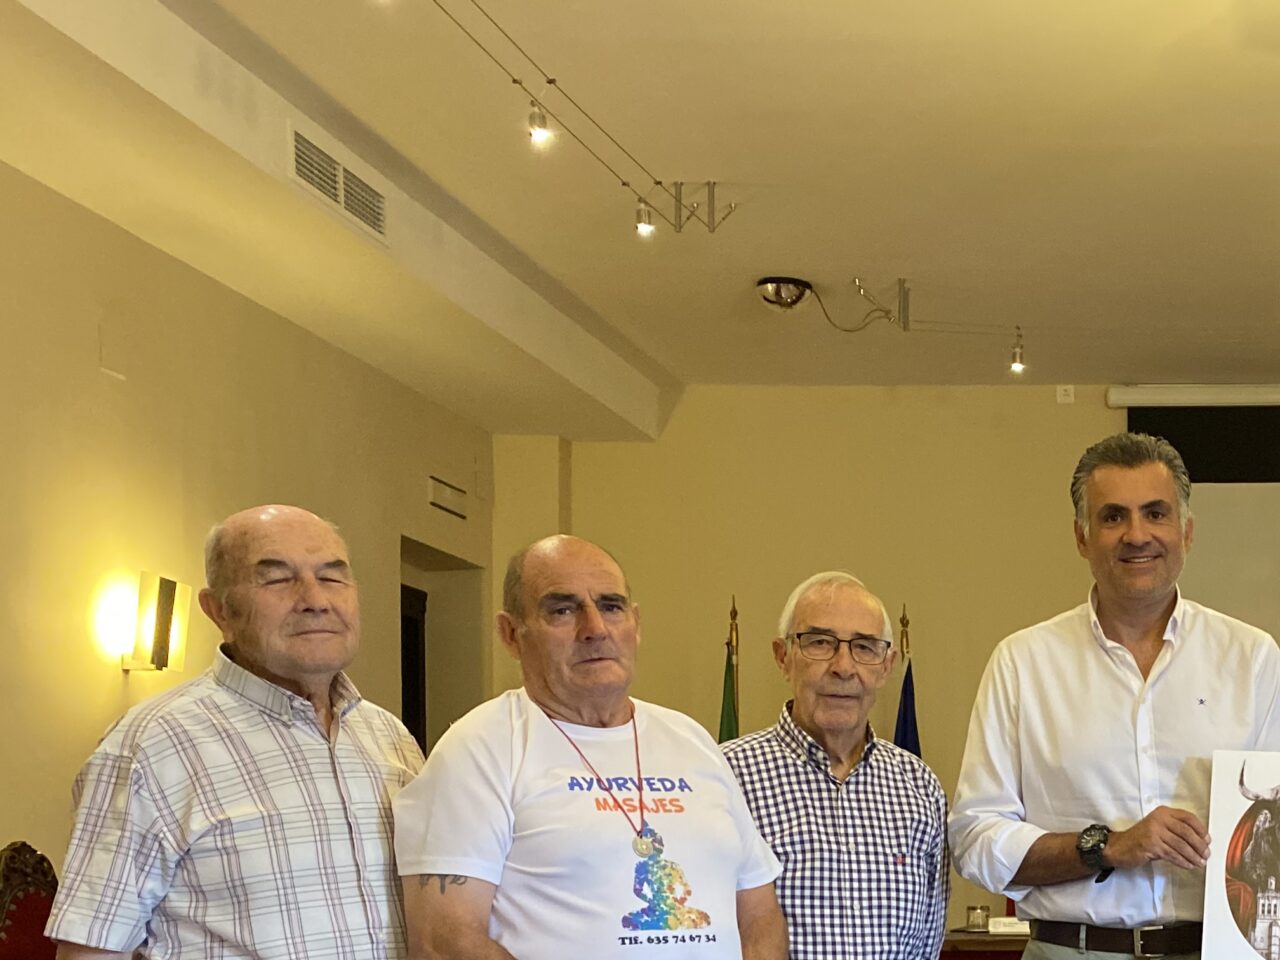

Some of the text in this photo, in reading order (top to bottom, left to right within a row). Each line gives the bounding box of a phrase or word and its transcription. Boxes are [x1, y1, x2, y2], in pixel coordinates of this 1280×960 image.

[567, 776, 693, 792] AYURVEDA
[594, 797, 685, 814] MASAJES
[646, 935, 669, 944] 635
[672, 935, 686, 944] 74
[690, 934, 702, 943] 67
[704, 934, 717, 943] 34
